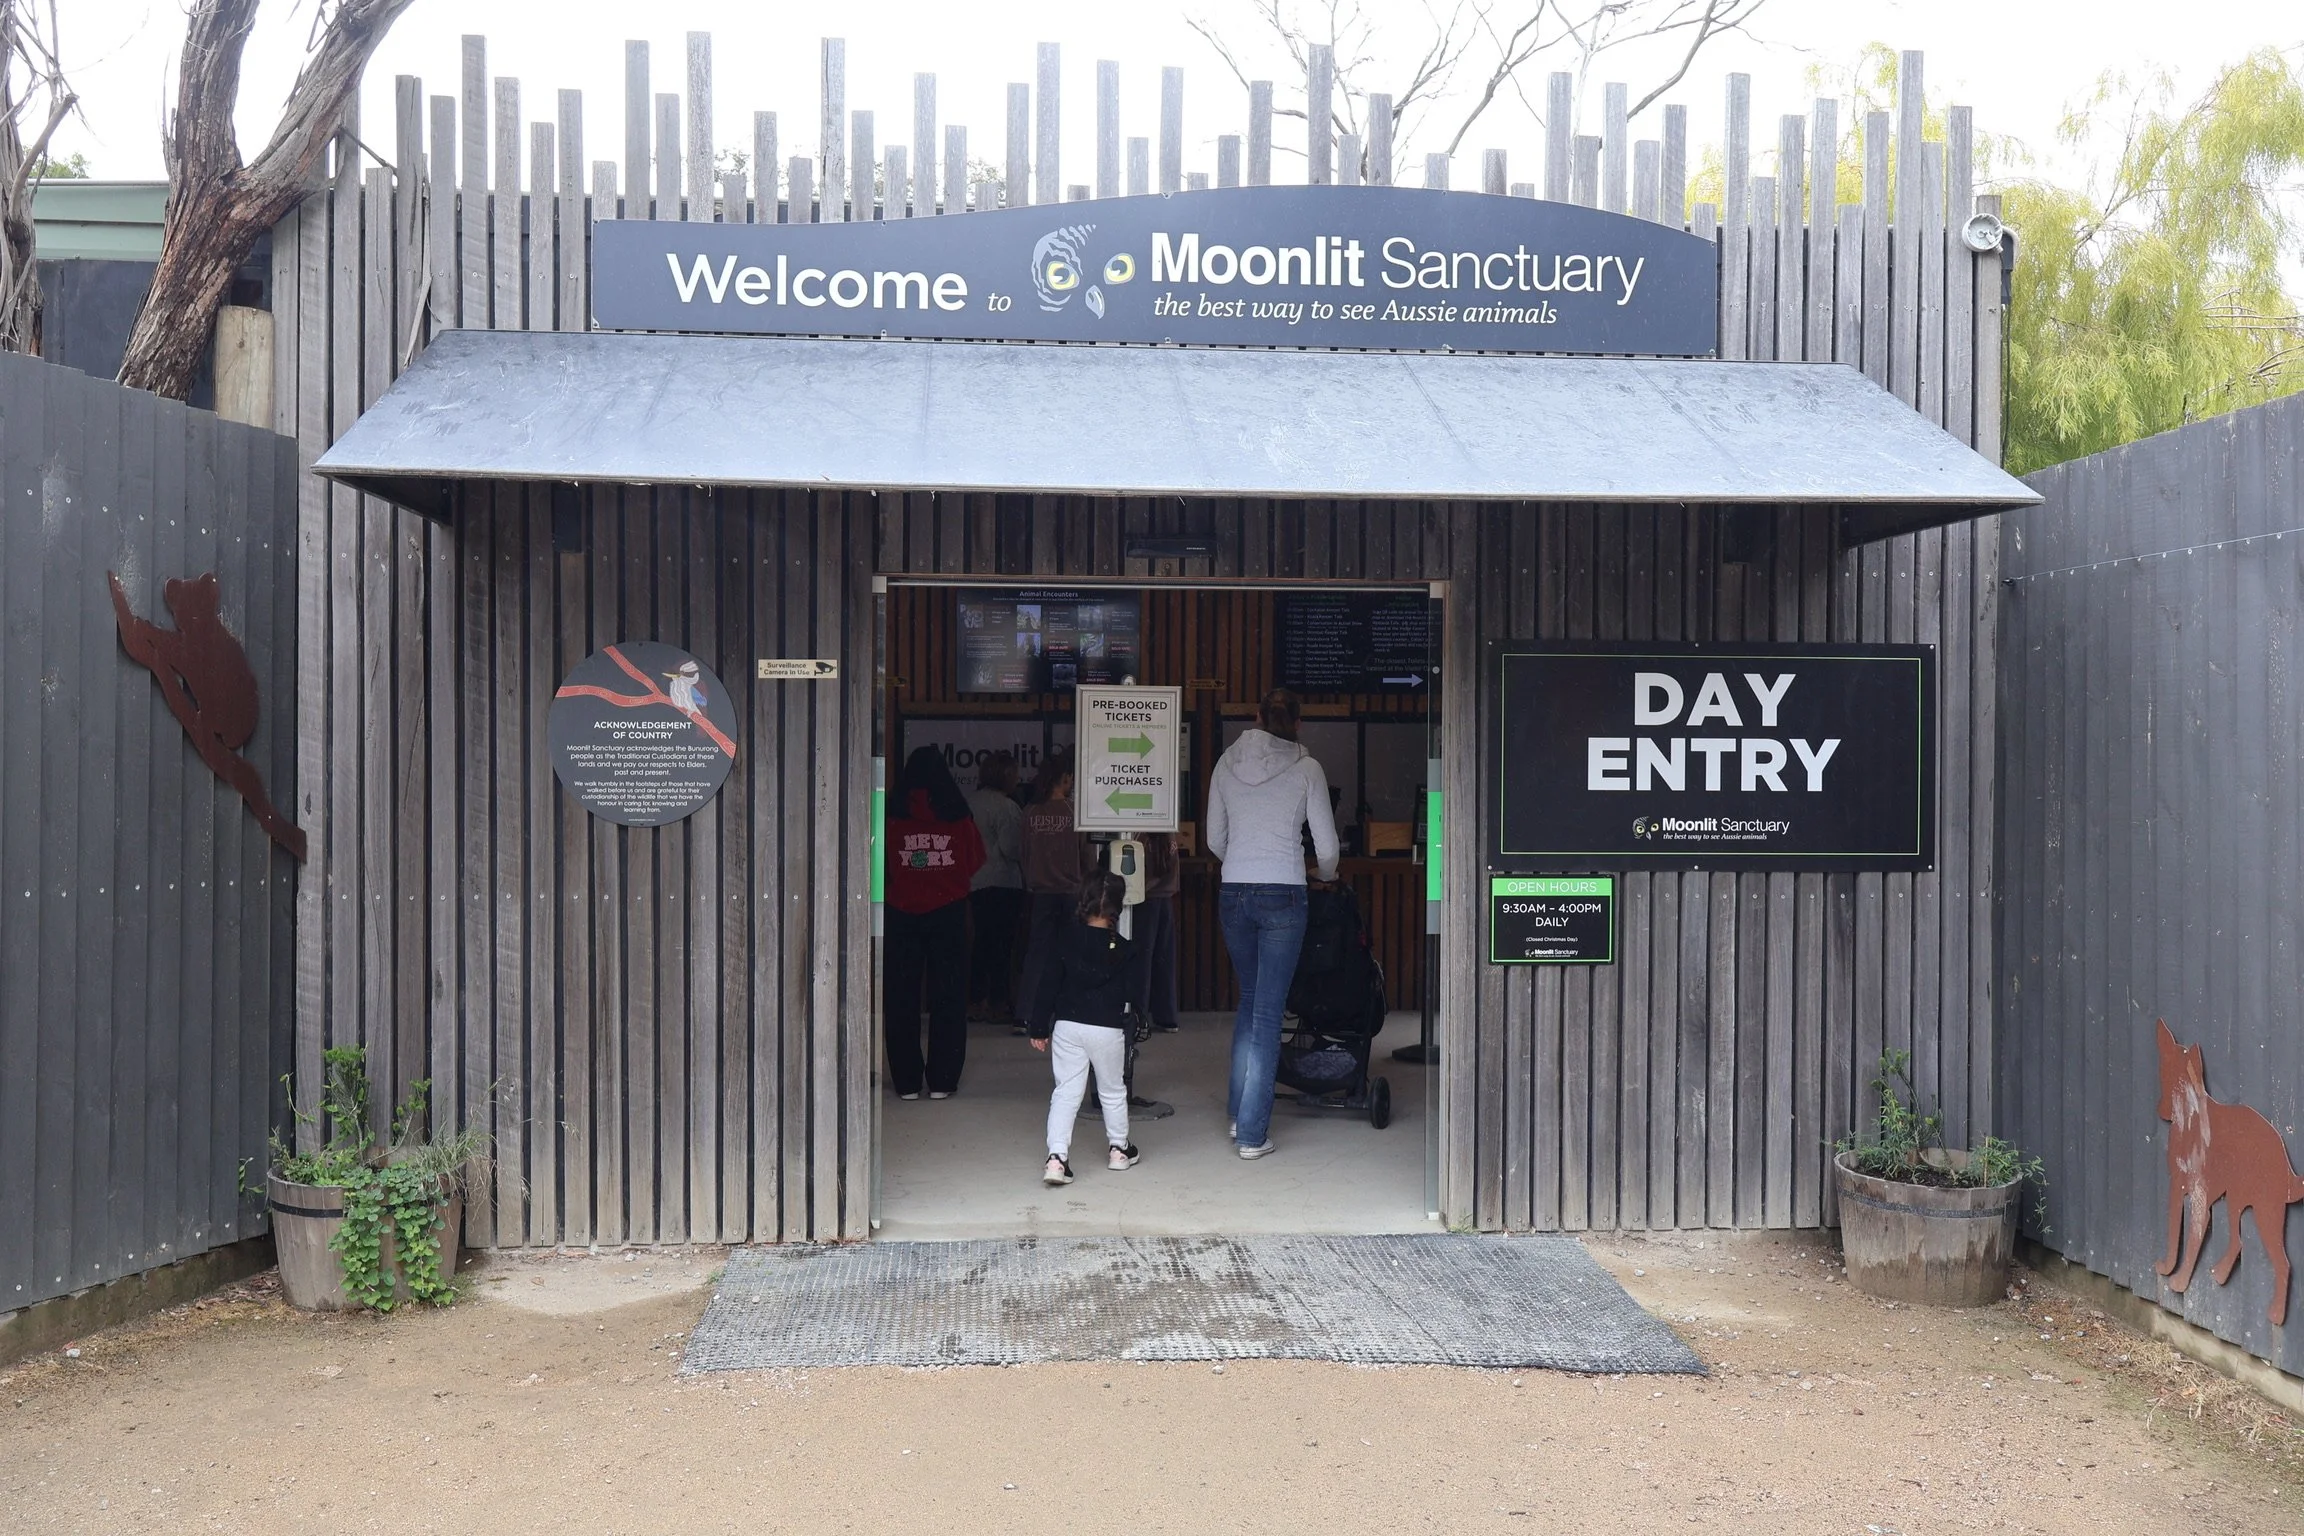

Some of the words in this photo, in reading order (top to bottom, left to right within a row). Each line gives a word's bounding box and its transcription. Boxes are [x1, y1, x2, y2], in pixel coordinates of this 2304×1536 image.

[1150, 232, 1365, 287] Moonlit
[1380, 236, 1645, 306] Sanctuary
[666, 252, 968, 311] Welcome
[987, 292, 1011, 312] to
[1153, 293, 1194, 317] the
[1198, 294, 1244, 318] best
[1251, 301, 1303, 325] way
[1311, 299, 1333, 320] to
[1339, 304, 1375, 321] see
[1379, 299, 1457, 323] Aussie
[1462, 300, 1557, 325] animals
[1634, 671, 1797, 727] DAY
[1092, 700, 1168, 710] PRE-BOOKED
[1105, 712, 1152, 722] TICKETS
[593, 721, 692, 730] ACKNOWLEDGEMENT
[612, 731, 626, 739] OF
[628, 731, 673, 739] COUNTRY
[592, 745, 626, 753] Sanctuary
[626, 745, 674, 753] acknowledges
[687, 745, 719, 753] Bunurong
[649, 761, 677, 769] respects
[1110, 764, 1150, 774] TICKET
[1587, 737, 1841, 792] ENTRY
[1095, 777, 1163, 786] PURCHASES
[1662, 817, 1718, 832] Moonlit
[1721, 817, 1790, 835] Sanctuary
[903, 833, 952, 851] NEW
[898, 850, 956, 868] YORK
[1507, 882, 1545, 893] OPEN
[1550, 882, 1597, 893] HOURS
[1502, 903, 1546, 913] 9:30AM
[1558, 903, 1601, 913] 4:00PM
[1535, 917, 1569, 927] DAILY
[1554, 949, 1578, 957] Sanctuary
